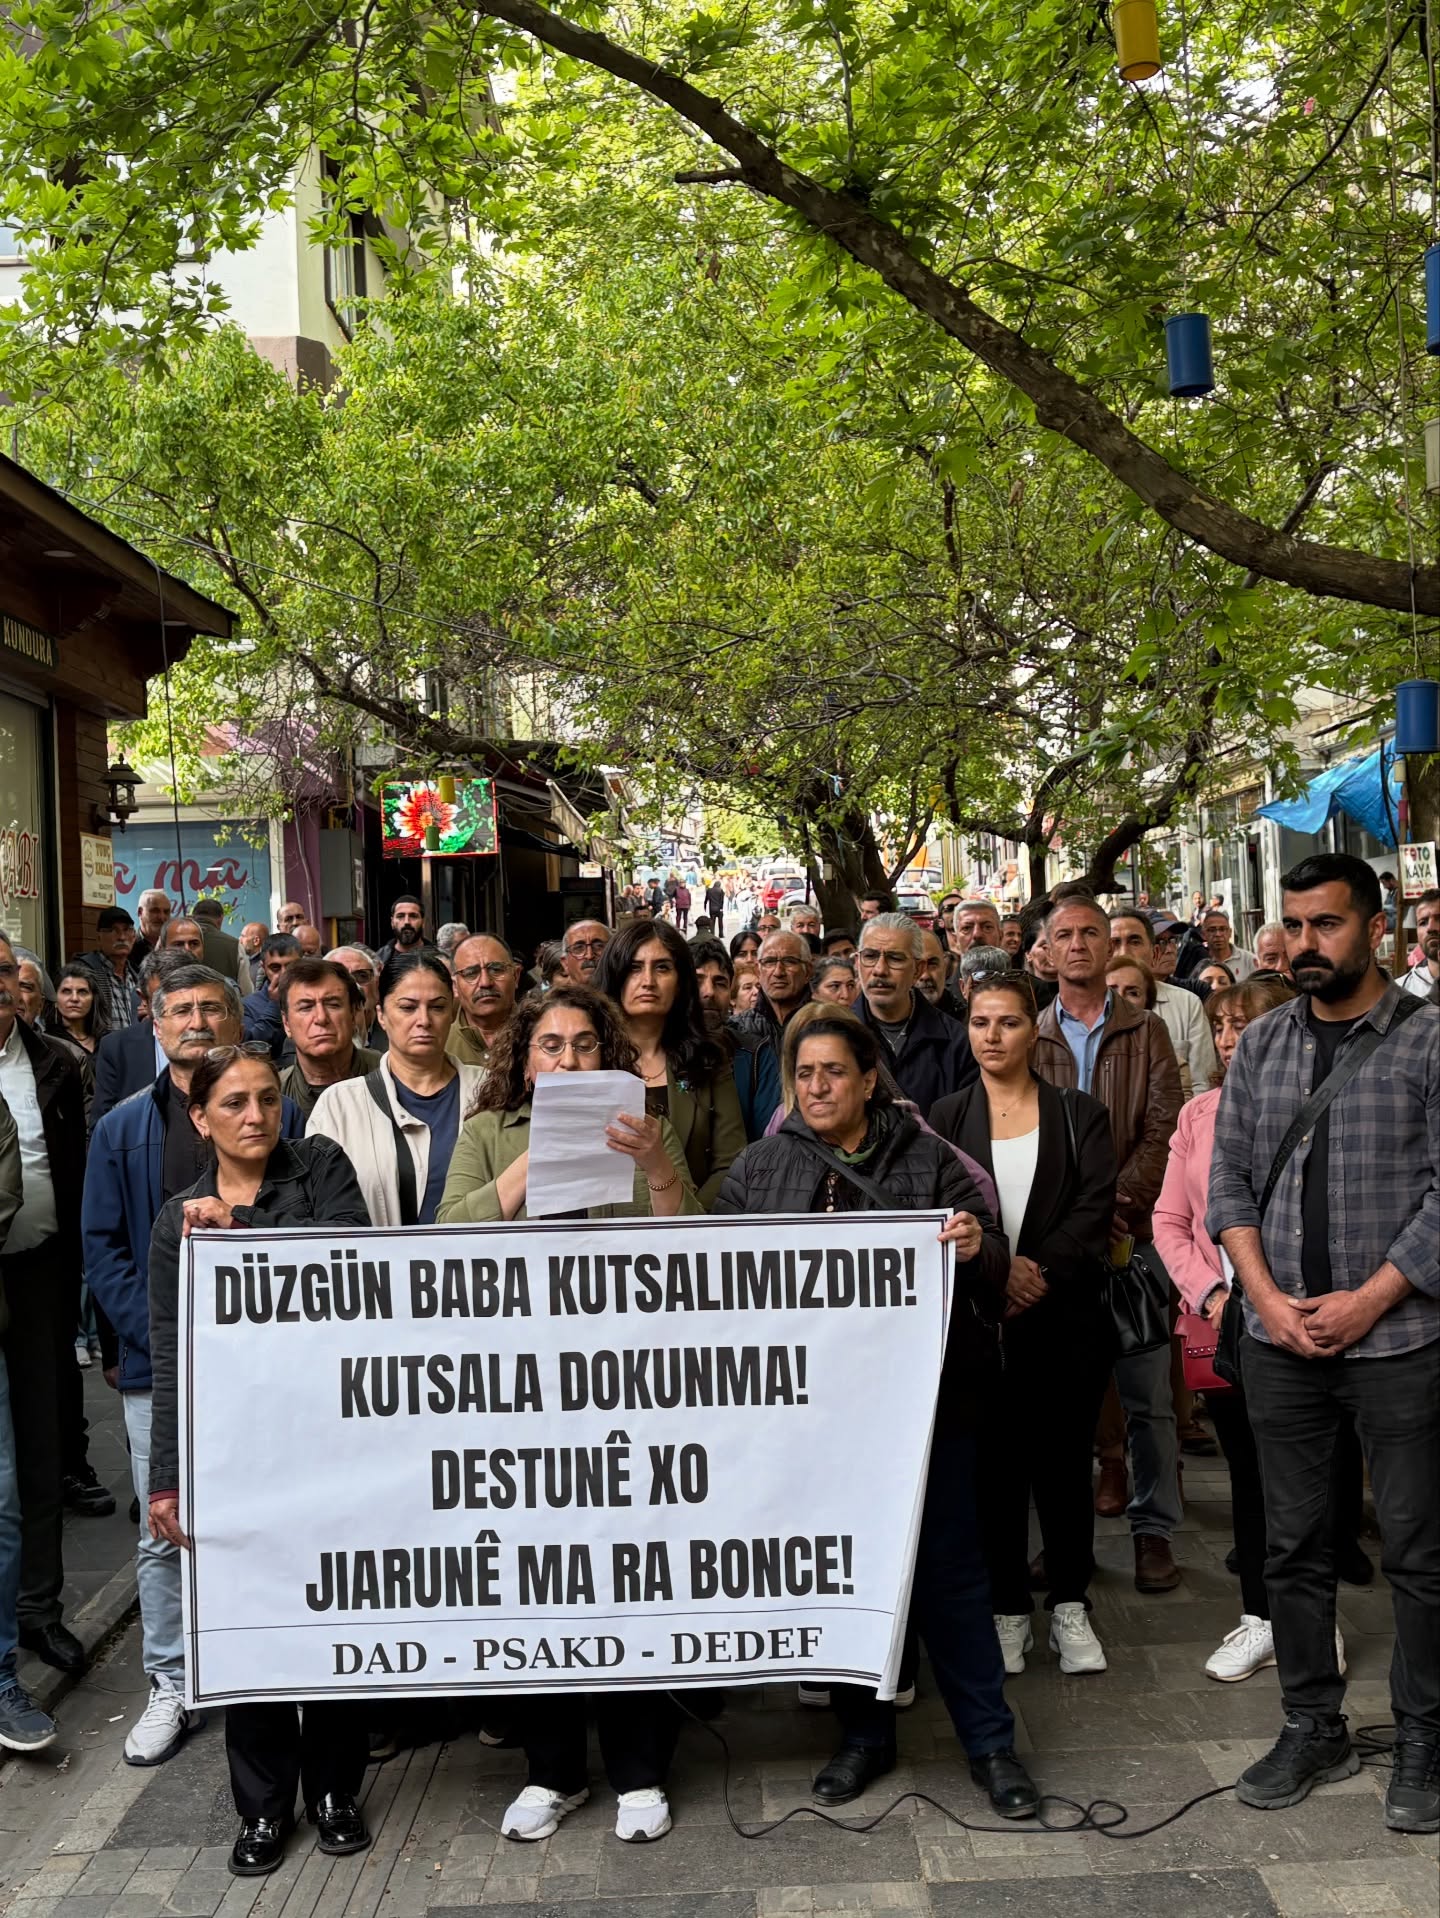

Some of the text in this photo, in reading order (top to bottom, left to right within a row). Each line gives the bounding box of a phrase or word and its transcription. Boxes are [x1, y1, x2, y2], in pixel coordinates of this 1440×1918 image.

[3, 615, 53, 667] KUNDURA
[1405, 863, 1432, 879] KAYA
[214, 1247, 917, 1325] DÜZGÜN BABA KUTSALIMIZDIR!
[341, 1345, 809, 1419] KUTSALA DOKUNMA!
[431, 1429, 709, 1511] DESTUNÊ XO
[305, 1529, 854, 1612] JIARUNÊ MA RA BONCE!
[332, 1641, 427, 1675] DAD
[473, 1635, 625, 1671] PSAKD
[670, 1626, 823, 1665] DEDEF
